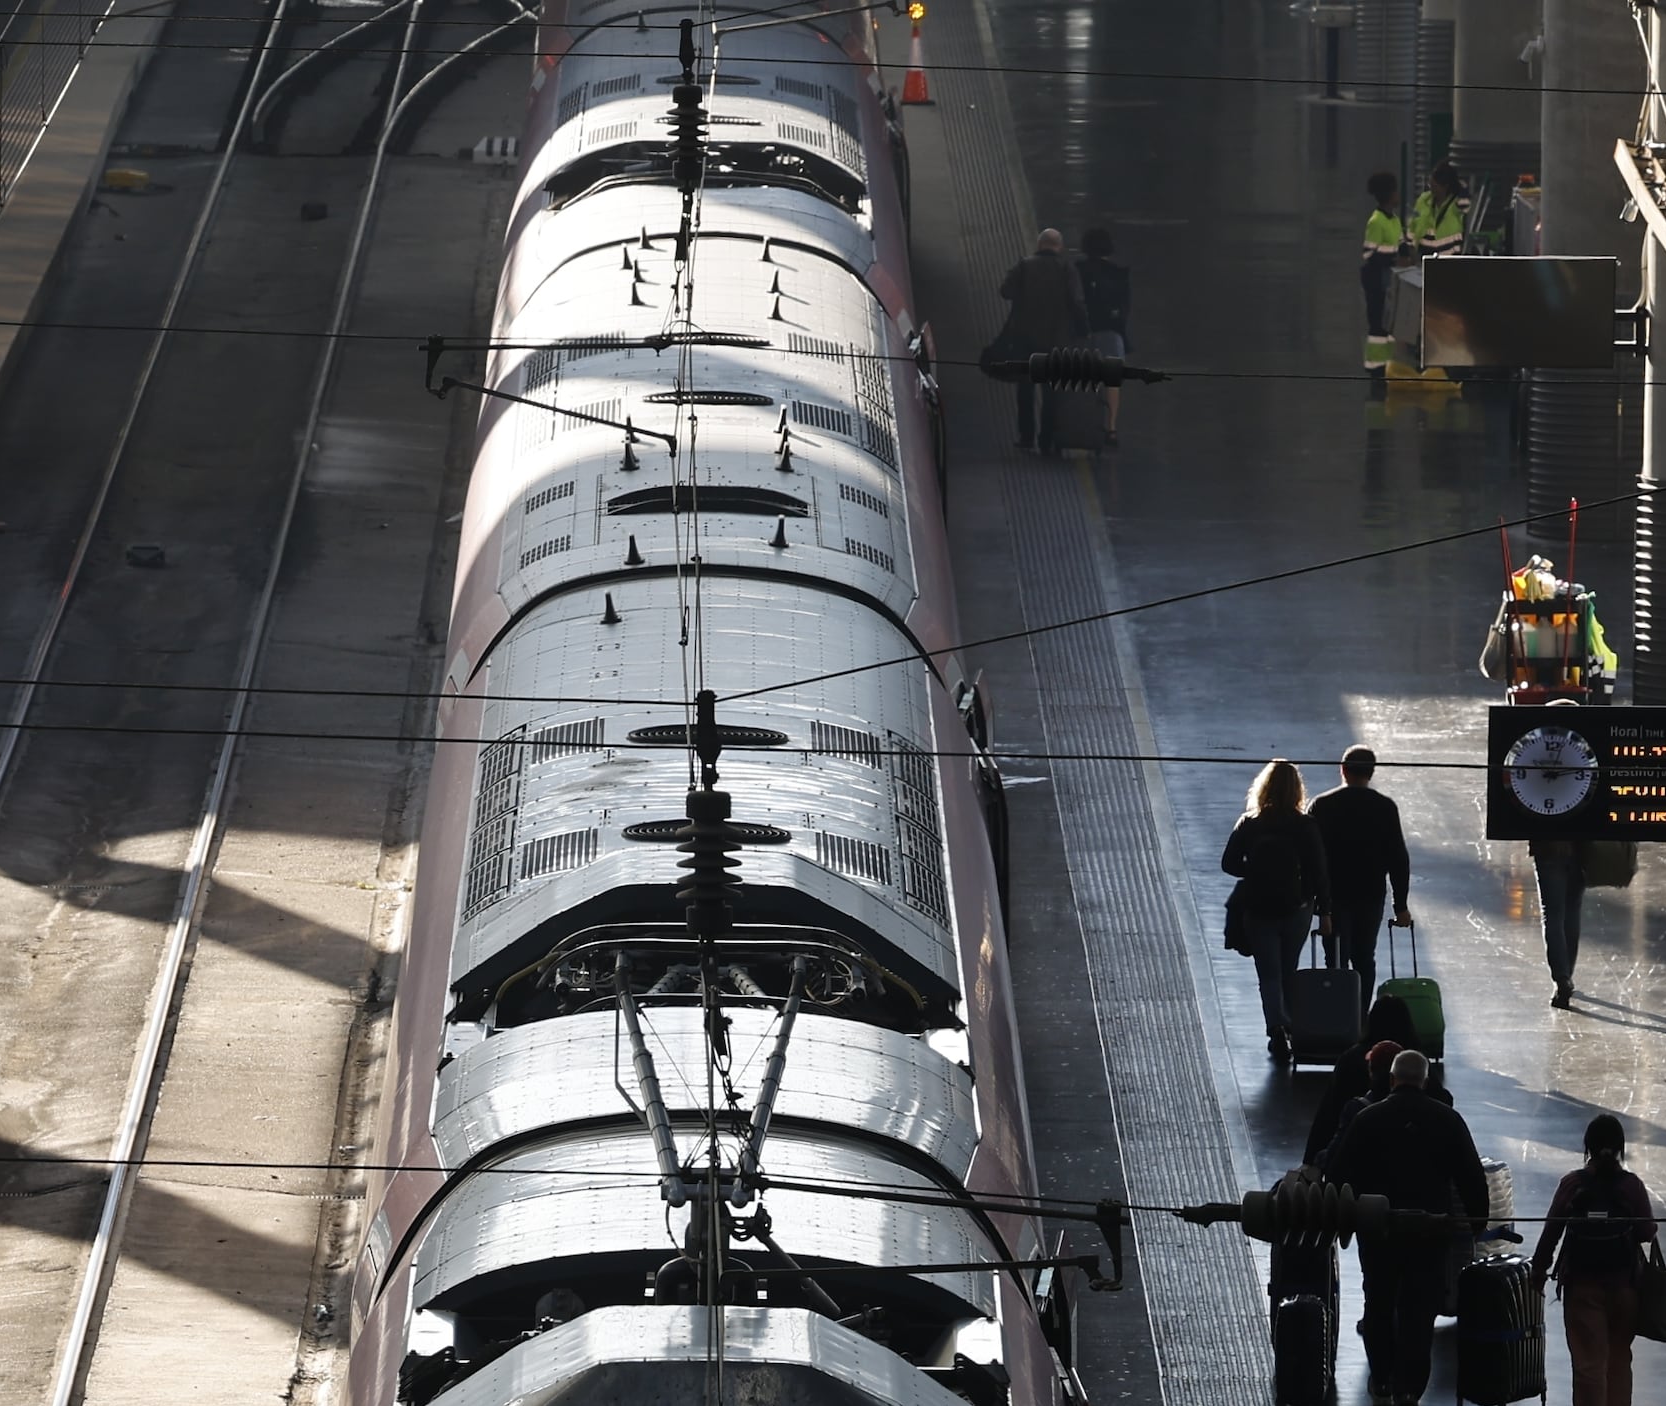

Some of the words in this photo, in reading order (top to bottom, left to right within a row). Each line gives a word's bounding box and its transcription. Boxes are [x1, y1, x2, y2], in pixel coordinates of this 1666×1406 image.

[1610, 725, 1638, 738] Hora
[1645, 729, 1665, 738] TIME
[1545, 741, 1560, 752] 12
[1544, 799, 1555, 810] 6
